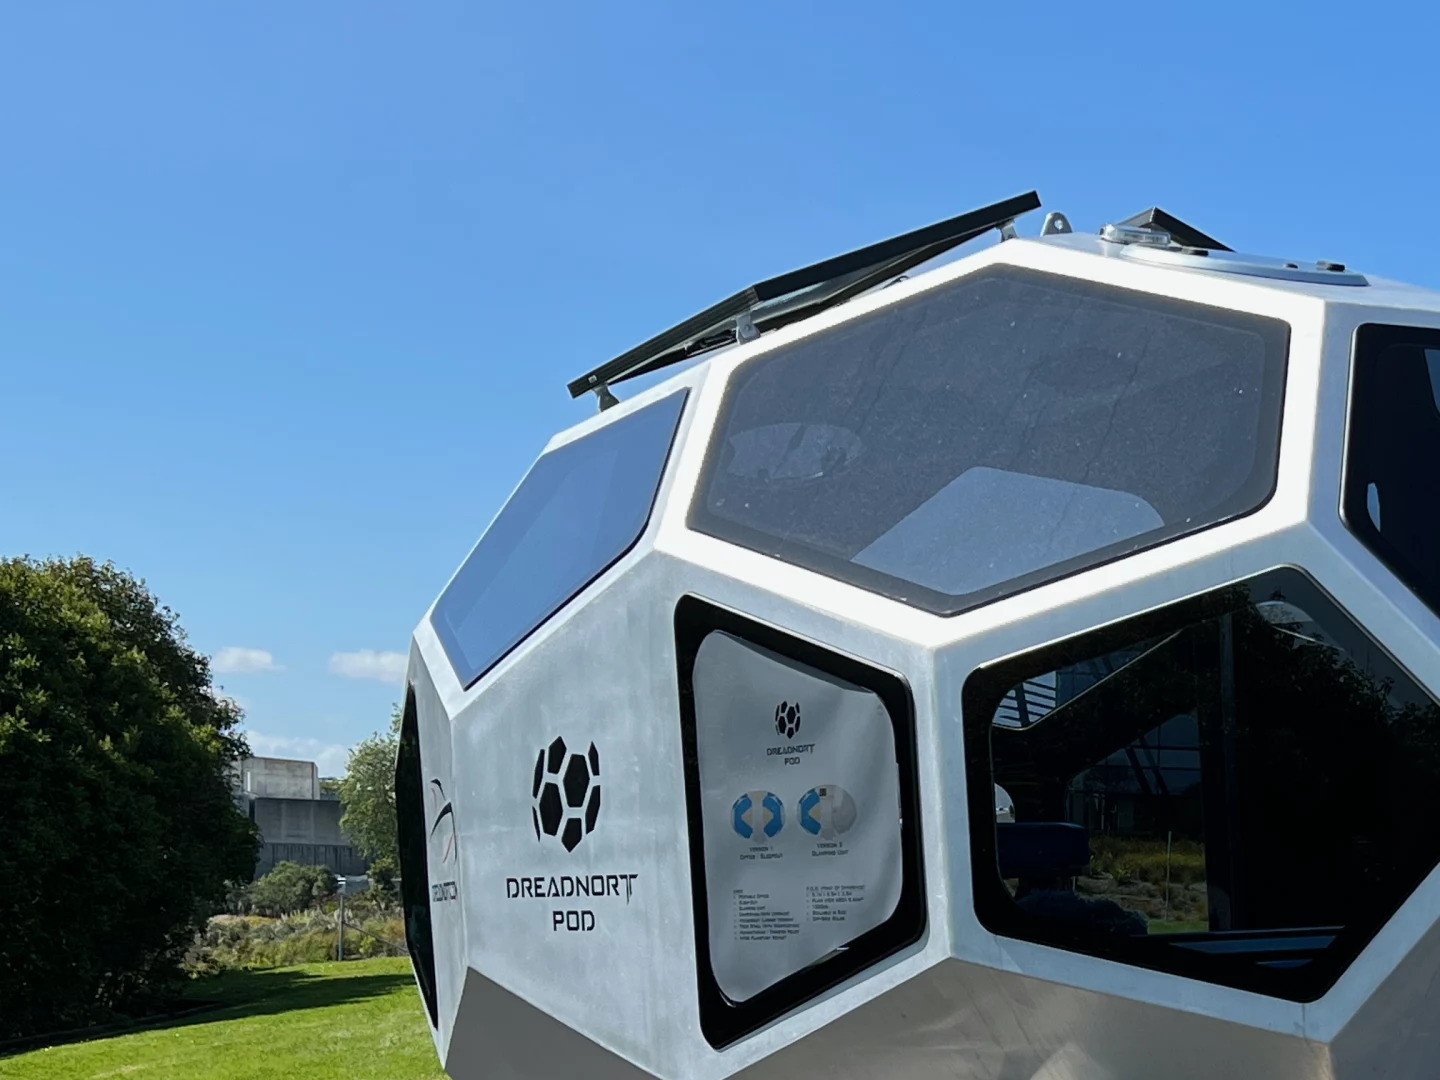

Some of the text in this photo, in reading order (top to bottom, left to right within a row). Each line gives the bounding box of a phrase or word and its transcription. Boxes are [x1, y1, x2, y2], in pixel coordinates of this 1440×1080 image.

[785, 757, 800, 766] POD
[506, 874, 639, 905] DREADNORT
[552, 910, 595, 931] POD
